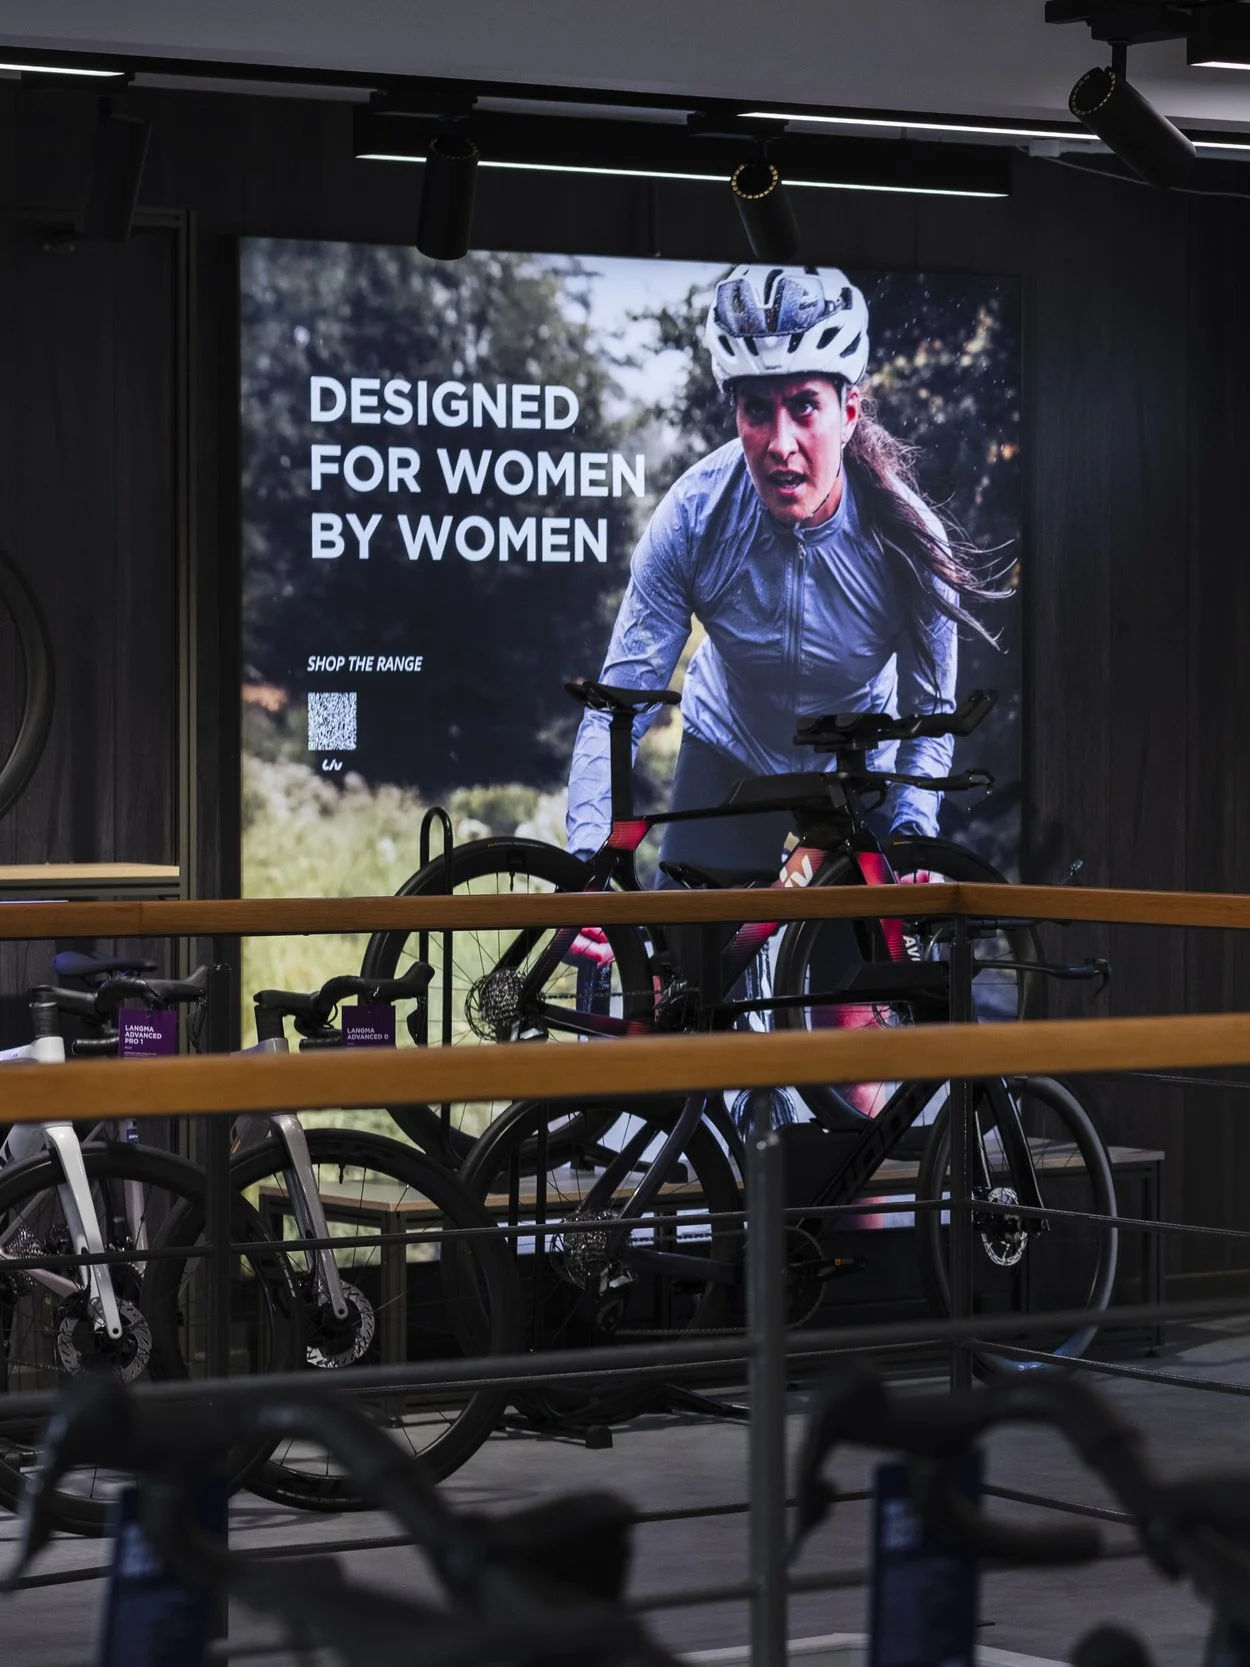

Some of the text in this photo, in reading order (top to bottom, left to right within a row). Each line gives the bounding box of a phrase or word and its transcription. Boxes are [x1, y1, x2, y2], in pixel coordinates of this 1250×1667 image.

[311, 376, 579, 429] DESIGNED
[311, 445, 645, 497] FOR WOMEN
[312, 513, 607, 562] BY WOMEN
[307, 656, 423, 671] SHOP THE RANGE
[124, 1024, 155, 1032] LANGMA
[124, 1031, 163, 1040] ADVANCED
[124, 1037, 139, 1045] PRO
